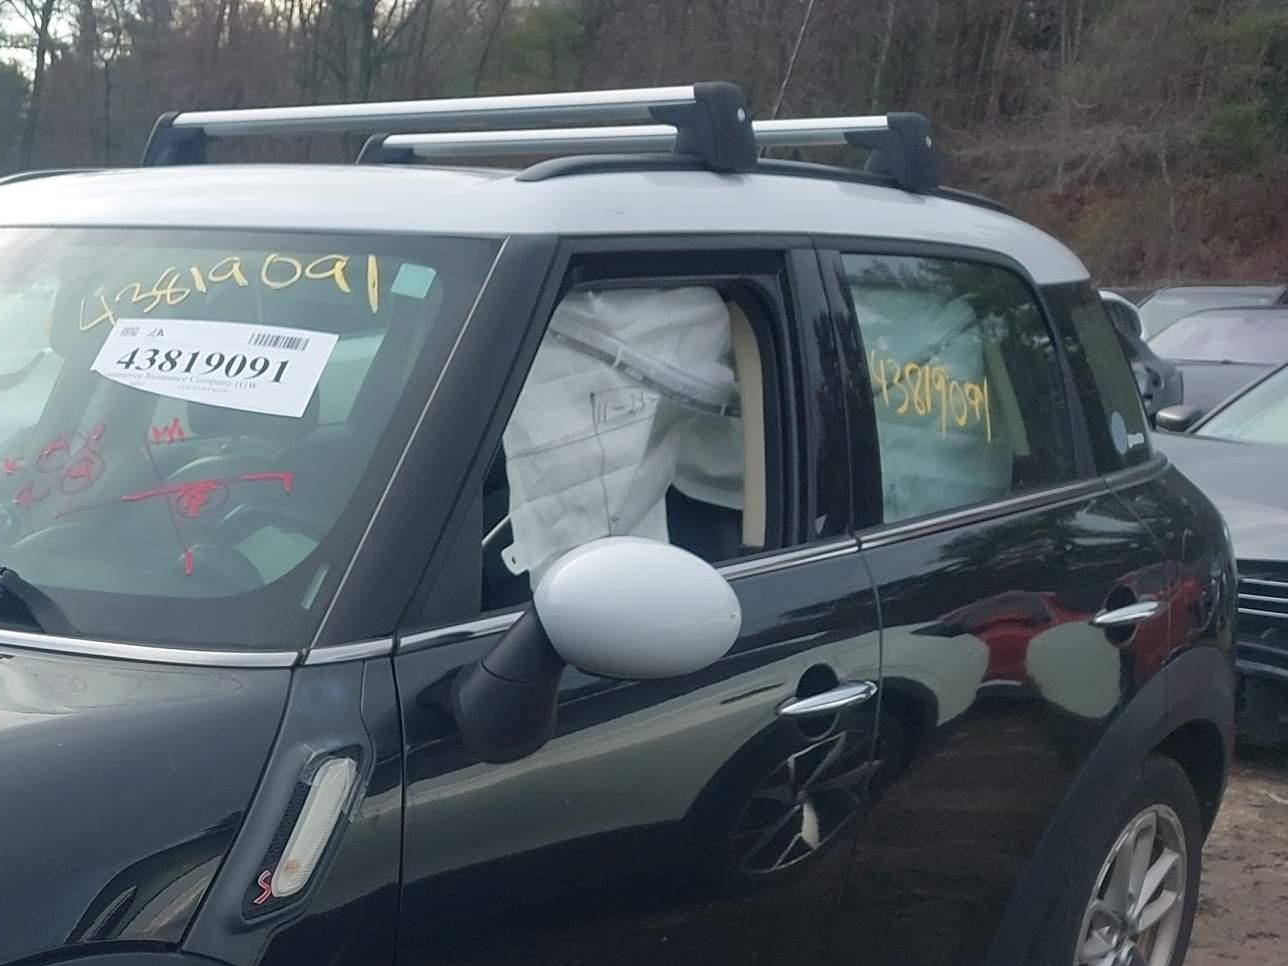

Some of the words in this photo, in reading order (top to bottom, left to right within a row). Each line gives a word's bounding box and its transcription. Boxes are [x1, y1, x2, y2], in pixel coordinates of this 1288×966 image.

[116, 346, 290, 384] 43819091
[869, 350, 991, 443] 43819091
[253, 870, 272, 904] S
